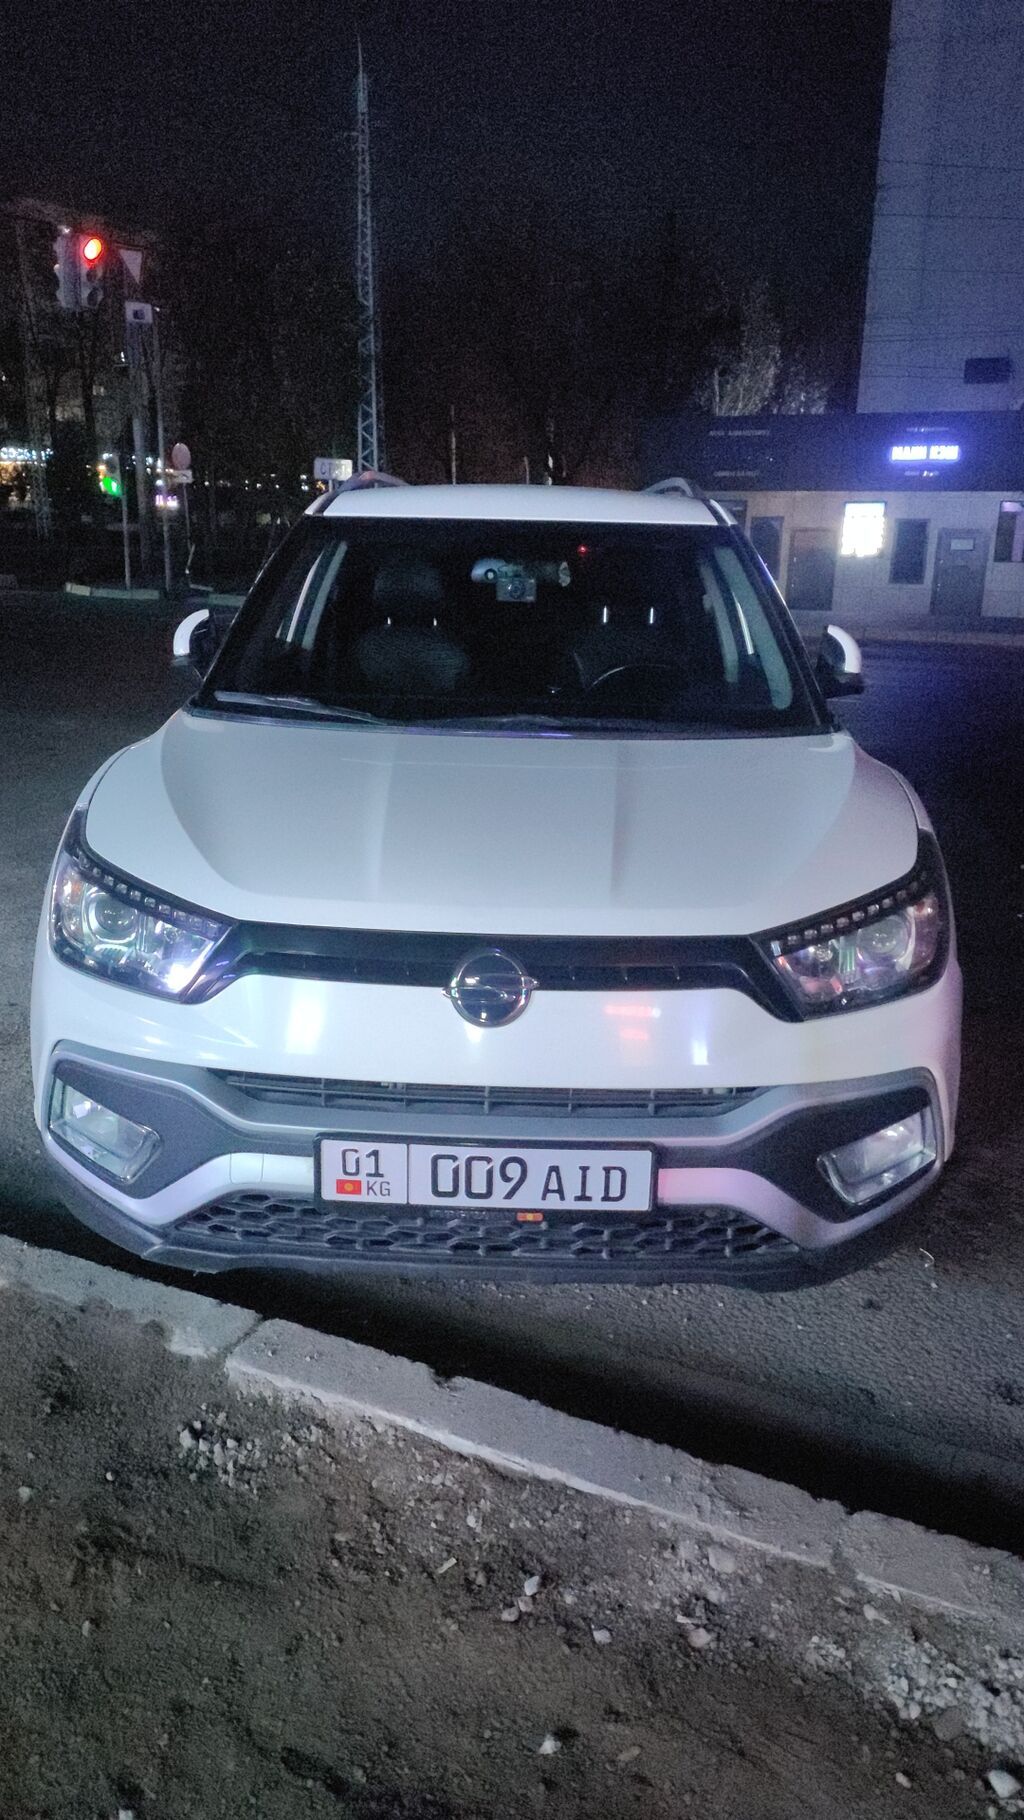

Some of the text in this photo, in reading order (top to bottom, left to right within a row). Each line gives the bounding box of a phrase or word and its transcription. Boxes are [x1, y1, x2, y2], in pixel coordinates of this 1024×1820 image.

[341, 1149, 385, 1177] 01
[366, 1181, 391, 1197] KG
[430, 1154, 627, 1202] 009 AID
